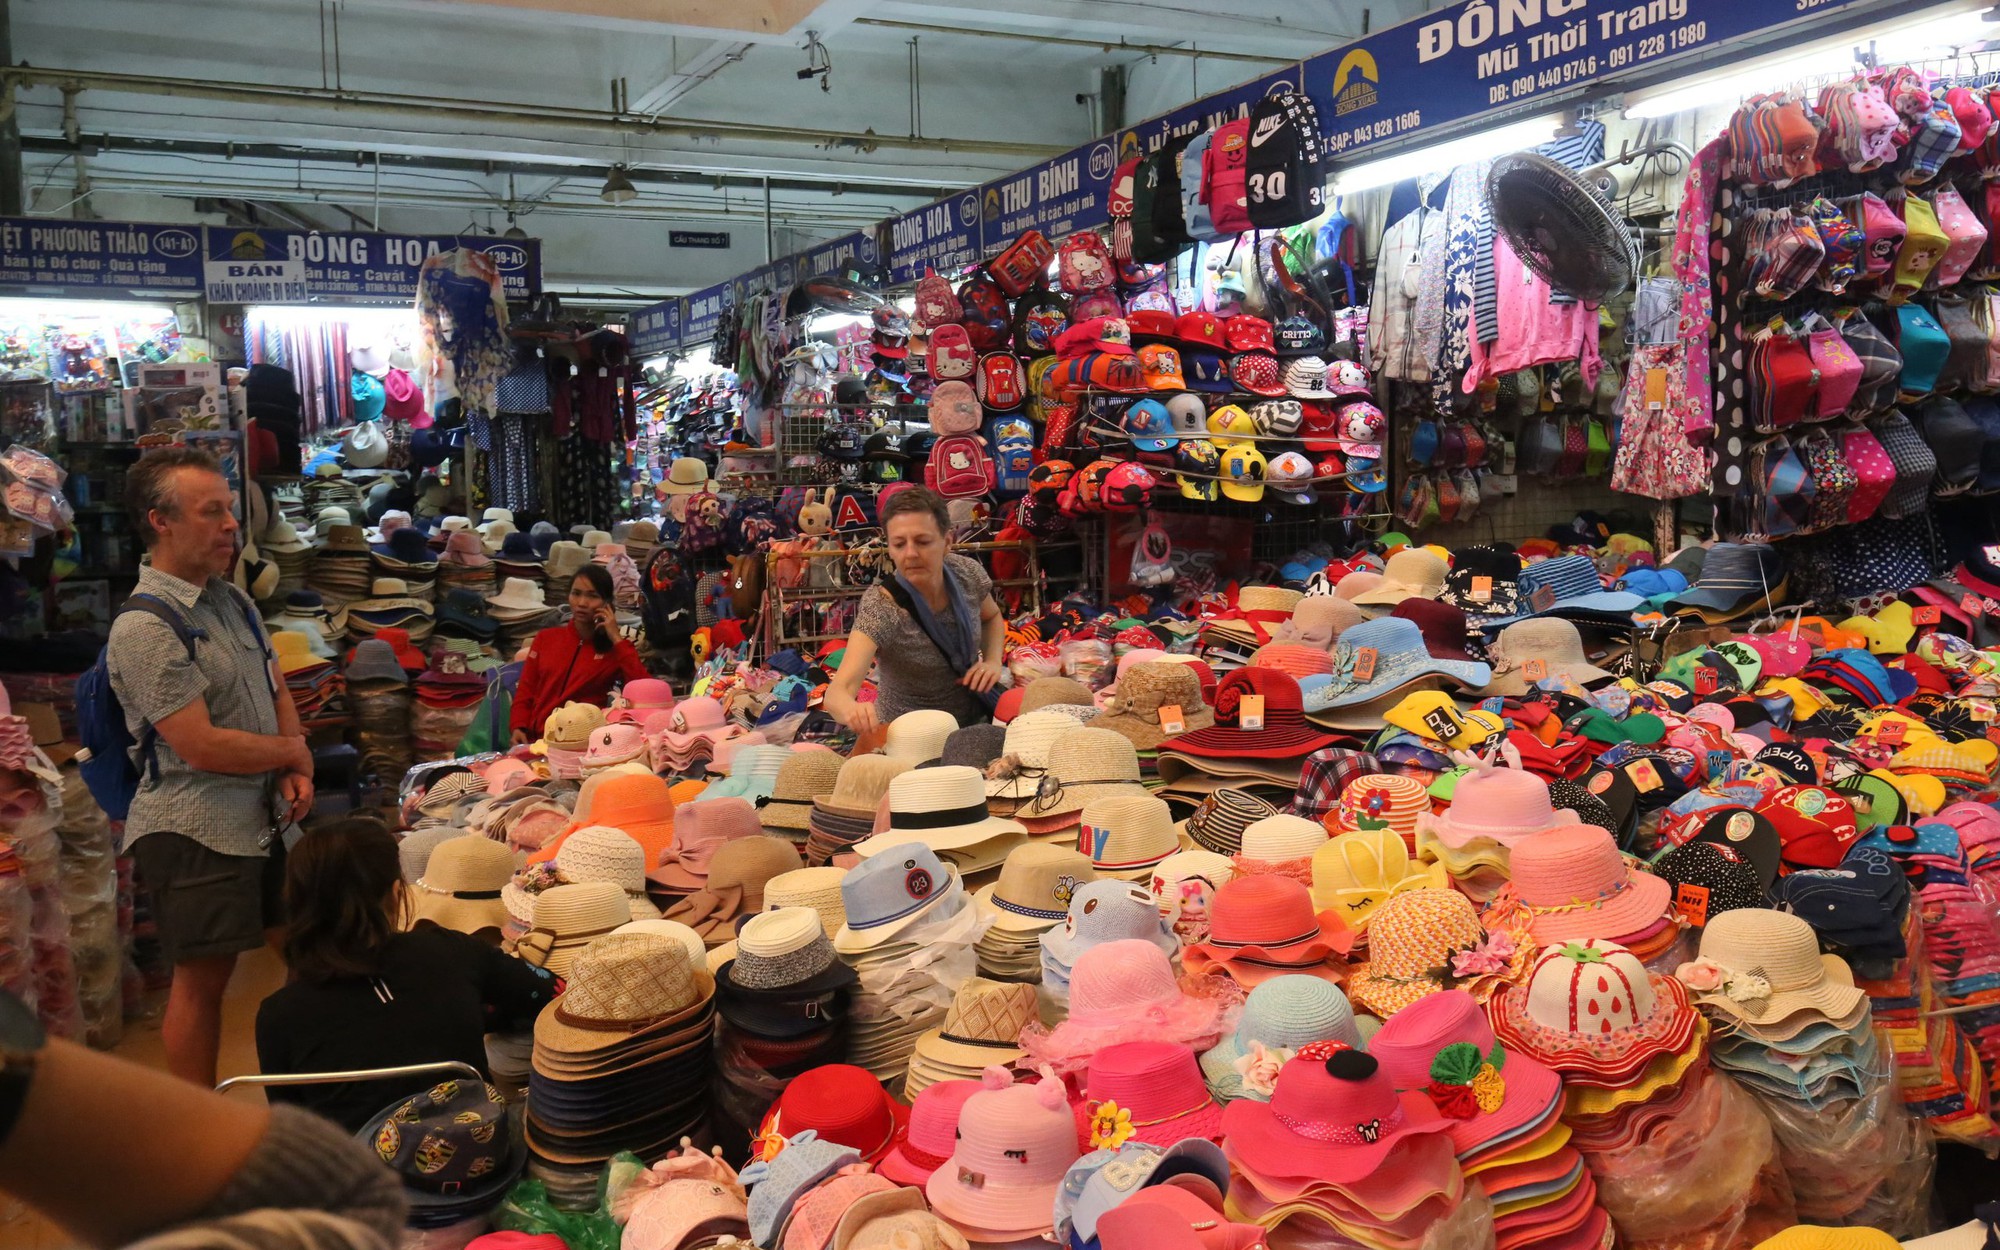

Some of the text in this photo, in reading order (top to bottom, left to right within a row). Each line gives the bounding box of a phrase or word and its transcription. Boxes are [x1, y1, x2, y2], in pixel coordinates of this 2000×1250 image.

[1478, 0, 1687, 79] Mũ Thời Trang
[1512, 76, 1535, 98] 090
[1538, 67, 1560, 89] 440
[1564, 56, 1596, 81] 9746
[1609, 46, 1633, 68] 091
[1639, 33, 1665, 57] 228
[1671, 21, 1706, 49] 1980
[1257, 113, 1282, 133] NIKE
[1331, 132, 1352, 153] SẠP:
[1354, 125, 1372, 144] 043
[1374, 118, 1393, 138] 928
[1395, 110, 1420, 132] 1606
[1002, 177, 1031, 214] THU
[1249, 171, 1287, 203] 30
[926, 203, 952, 239] HOA
[31, 227, 100, 252] PHƯƠNG
[106, 224, 149, 255] THẢO
[159, 236, 192, 250] 141-A1
[1012, 457, 1029, 472] 95
[835, 495, 868, 528] A
[912, 876, 928, 893] 23
